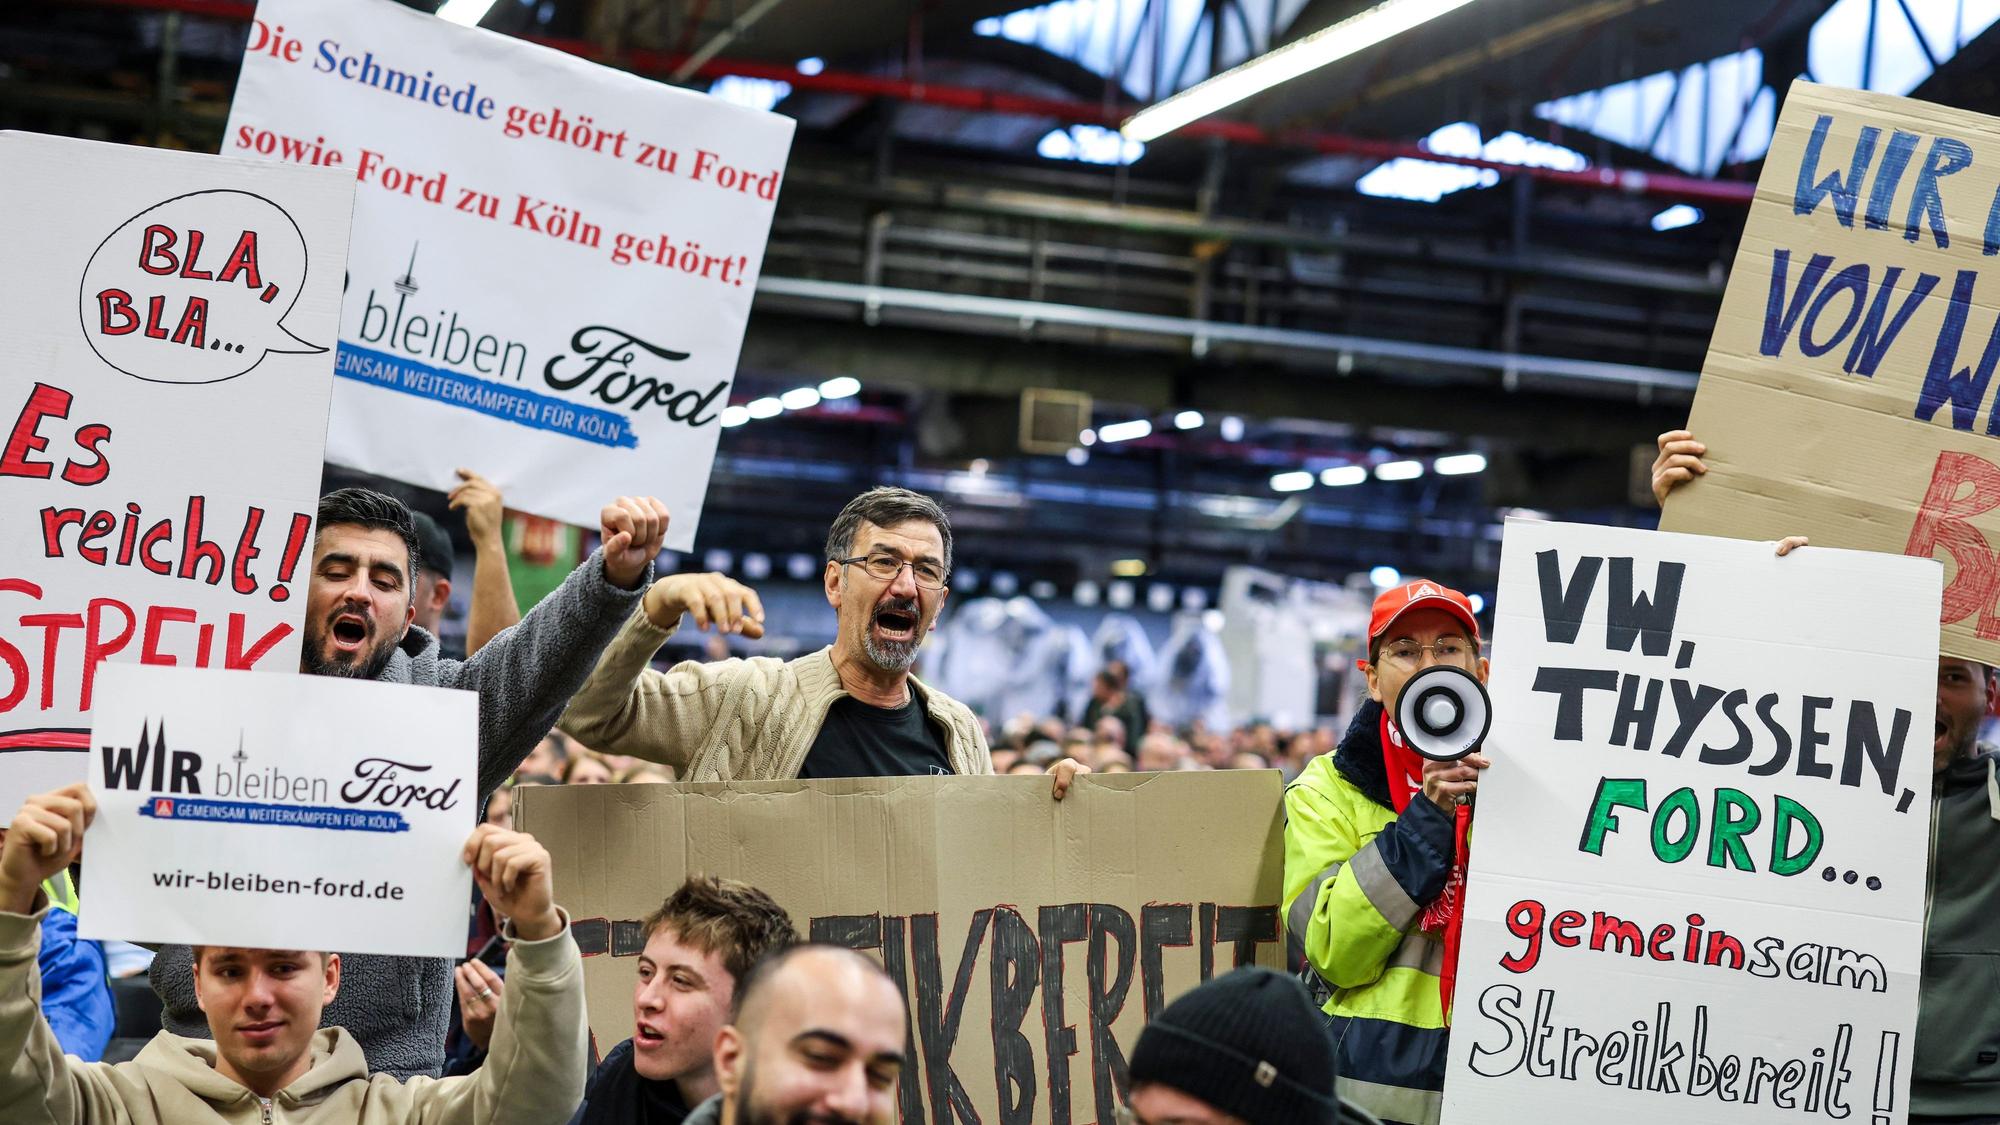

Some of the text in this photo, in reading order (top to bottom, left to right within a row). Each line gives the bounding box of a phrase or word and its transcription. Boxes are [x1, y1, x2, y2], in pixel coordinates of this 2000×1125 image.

[245, 18, 780, 202] Die Schmiede gehört zu Ford
[236, 123, 748, 288] sowie Ford zu Köln gehört!
[1793, 115, 1974, 249] WIR
[139, 224, 279, 304] BLA,
[1759, 248, 1941, 378] VON
[96, 288, 244, 350] BLA...
[359, 289, 730, 428] bleiben Ford
[0, 382, 112, 487] Es
[335, 350, 620, 442] EINSAM WEITERKÄMPFEN FÜR KÖLN
[40, 495, 313, 603] reicht!
[1535, 549, 1696, 669] VW,
[102, 715, 462, 812] WIR bleiben Ford
[1531, 666, 1915, 814] THYSSEN,
[177, 803, 397, 830] GEMEINSAM WEITERKÄMPFEN FÜR KÖLN
[153, 869, 404, 901] wir-bleiben-ford.de
[1499, 899, 1887, 993] gemeinsam
